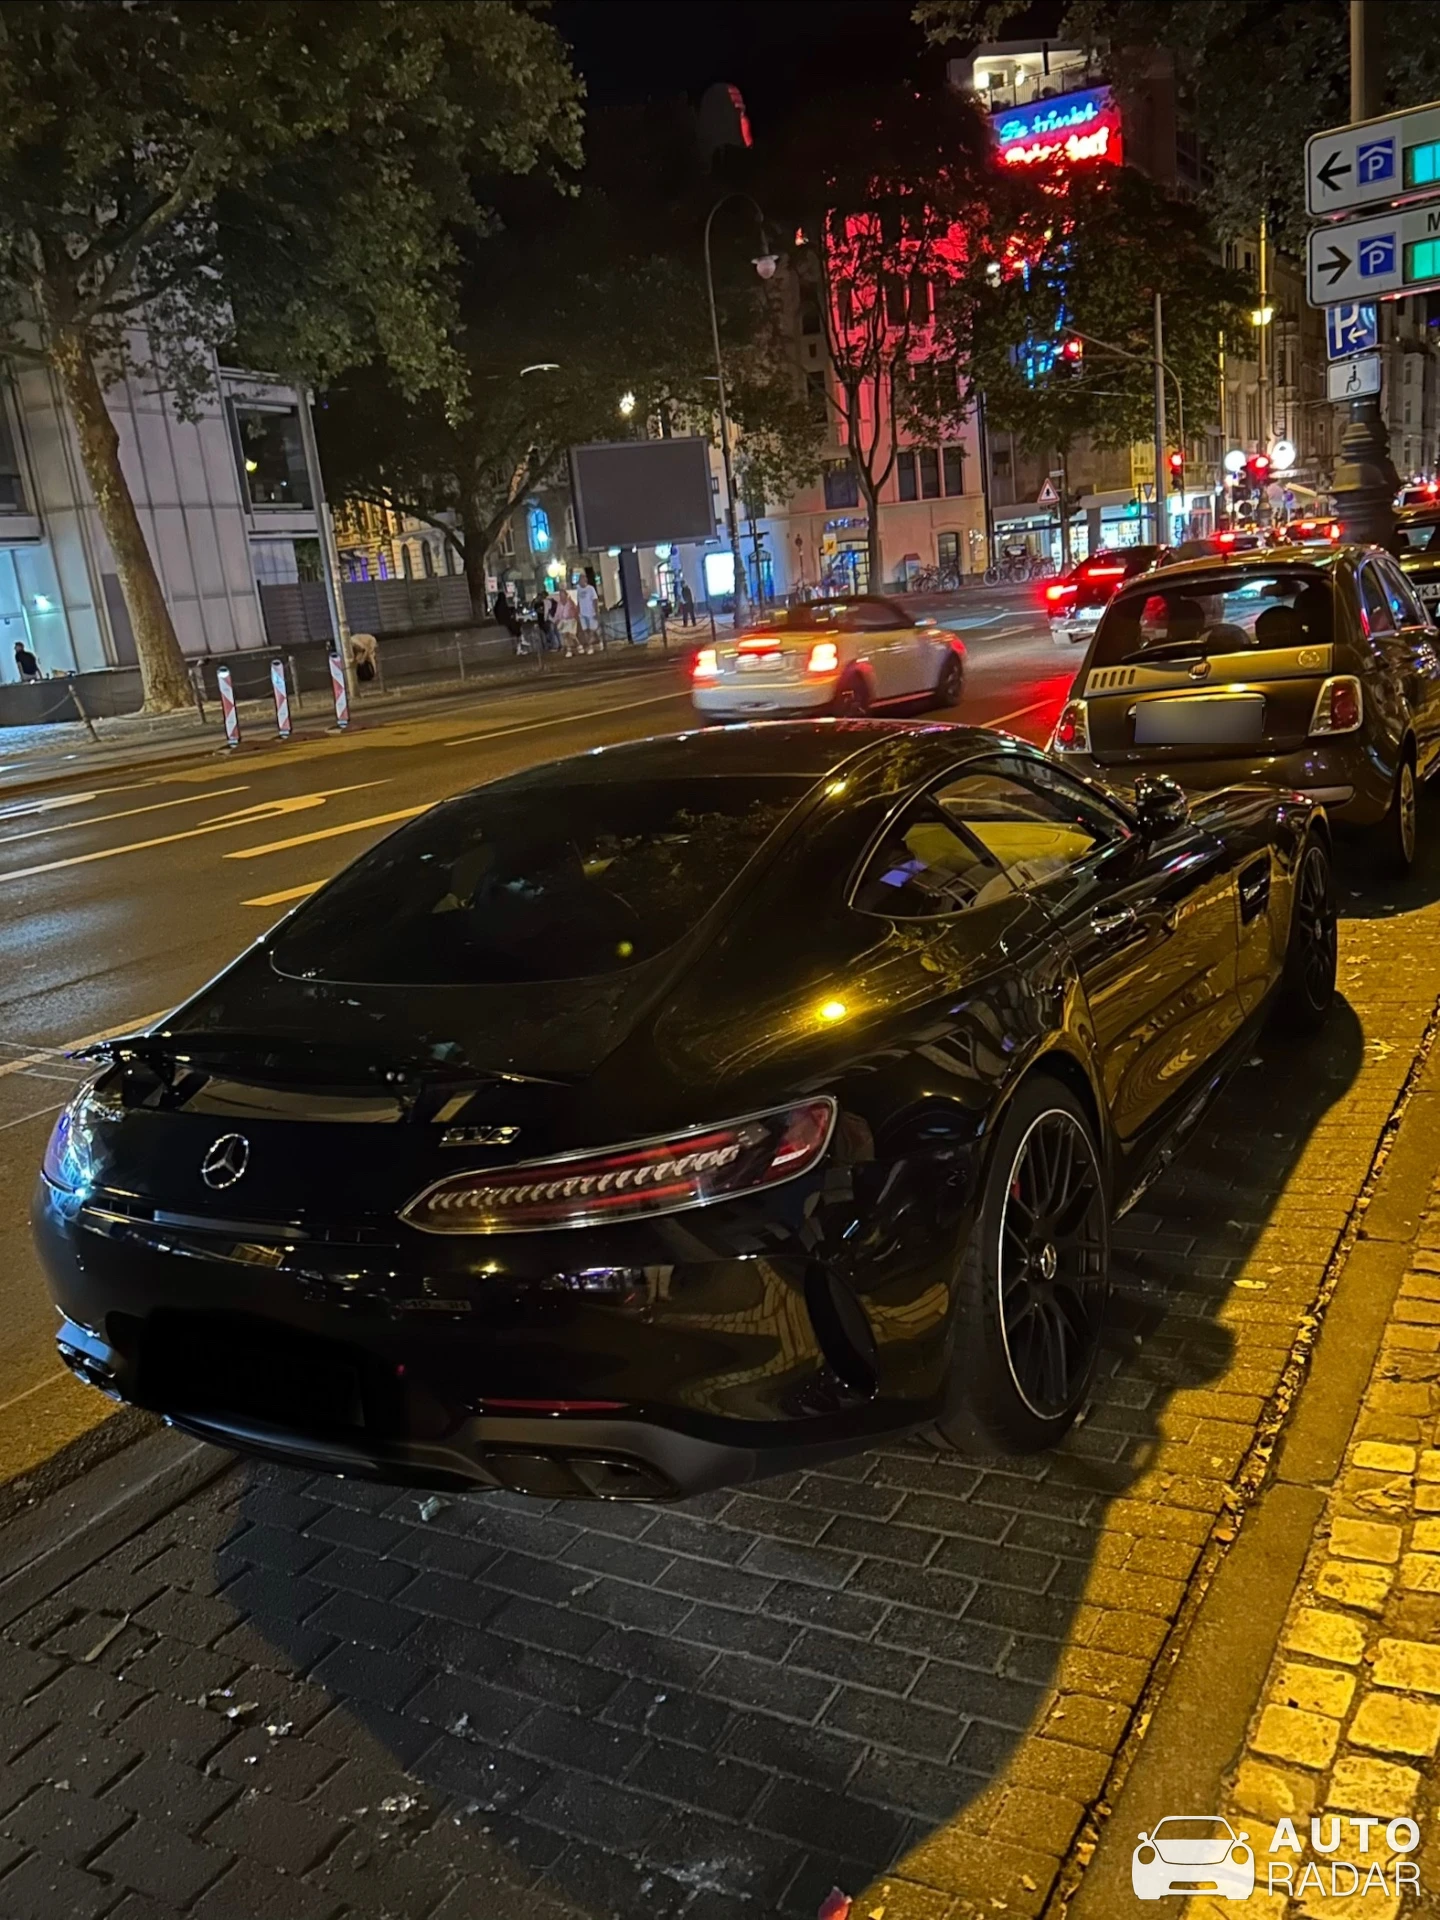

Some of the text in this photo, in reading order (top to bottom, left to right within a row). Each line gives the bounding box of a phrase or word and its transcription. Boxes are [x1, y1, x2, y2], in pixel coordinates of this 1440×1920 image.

[1032, 102, 1098, 133] trinkt
[1368, 155, 1385, 180] P
[1369, 250, 1385, 274] P
